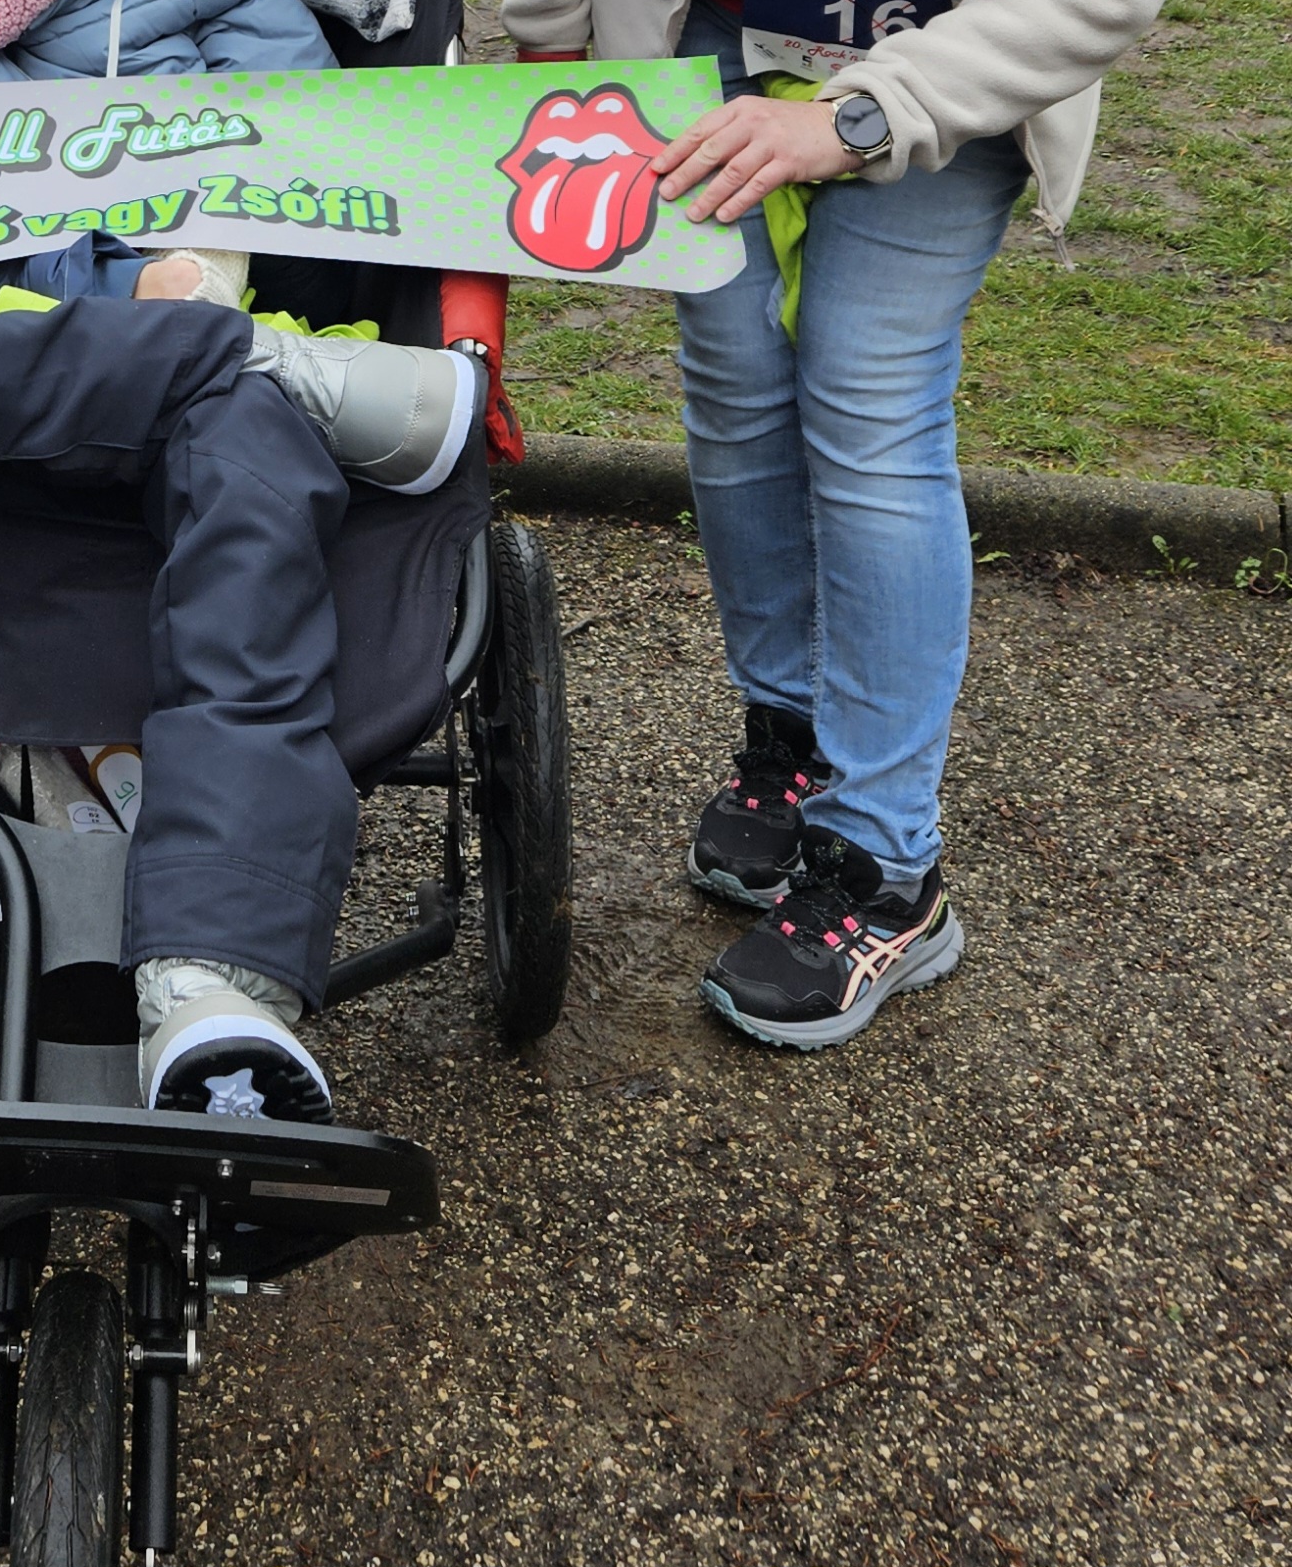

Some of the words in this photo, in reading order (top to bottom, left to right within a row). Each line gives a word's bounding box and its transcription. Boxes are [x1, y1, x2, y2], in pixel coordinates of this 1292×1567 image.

[784, 38, 804, 51] 20.
[60, 103, 258, 176] Futás
[20, 189, 196, 237] vagy
[198, 174, 396, 232] Zsófi!
